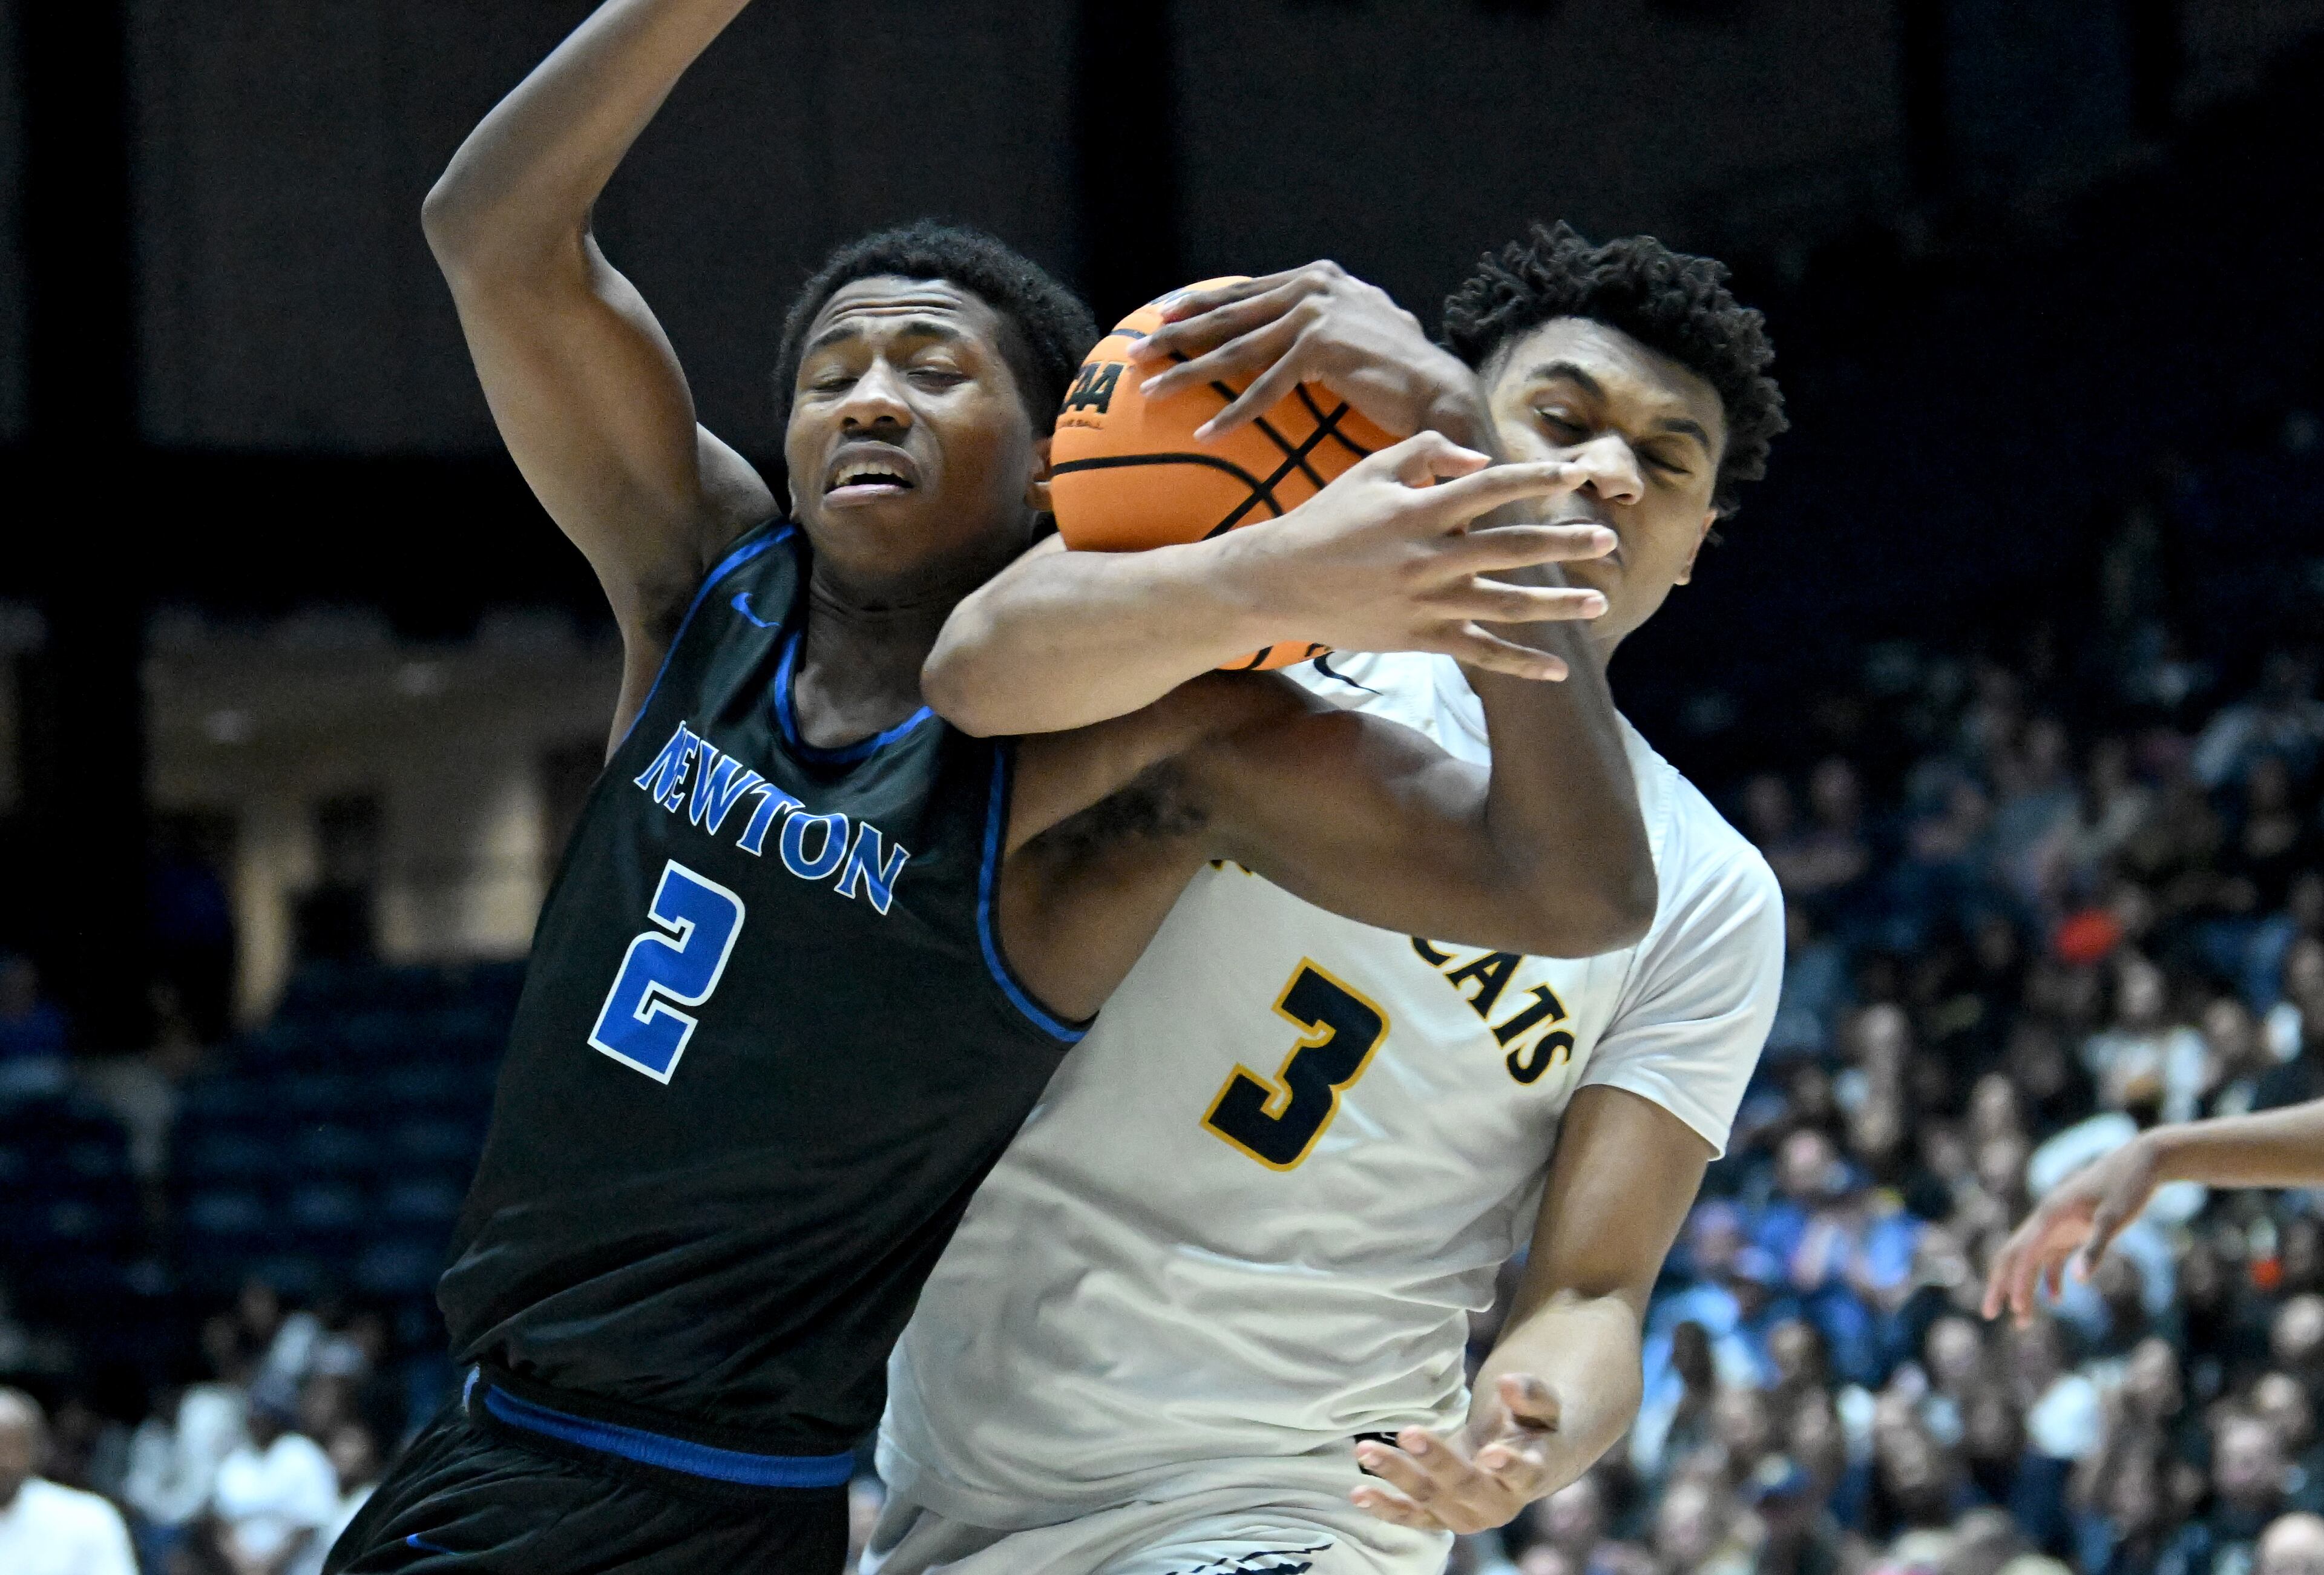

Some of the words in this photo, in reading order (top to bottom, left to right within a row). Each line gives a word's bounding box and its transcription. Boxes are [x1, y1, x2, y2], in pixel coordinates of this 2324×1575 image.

[633, 720, 910, 916] NEWTON
[587, 858, 746, 1085] 2
[1199, 956, 1390, 1172] 3
